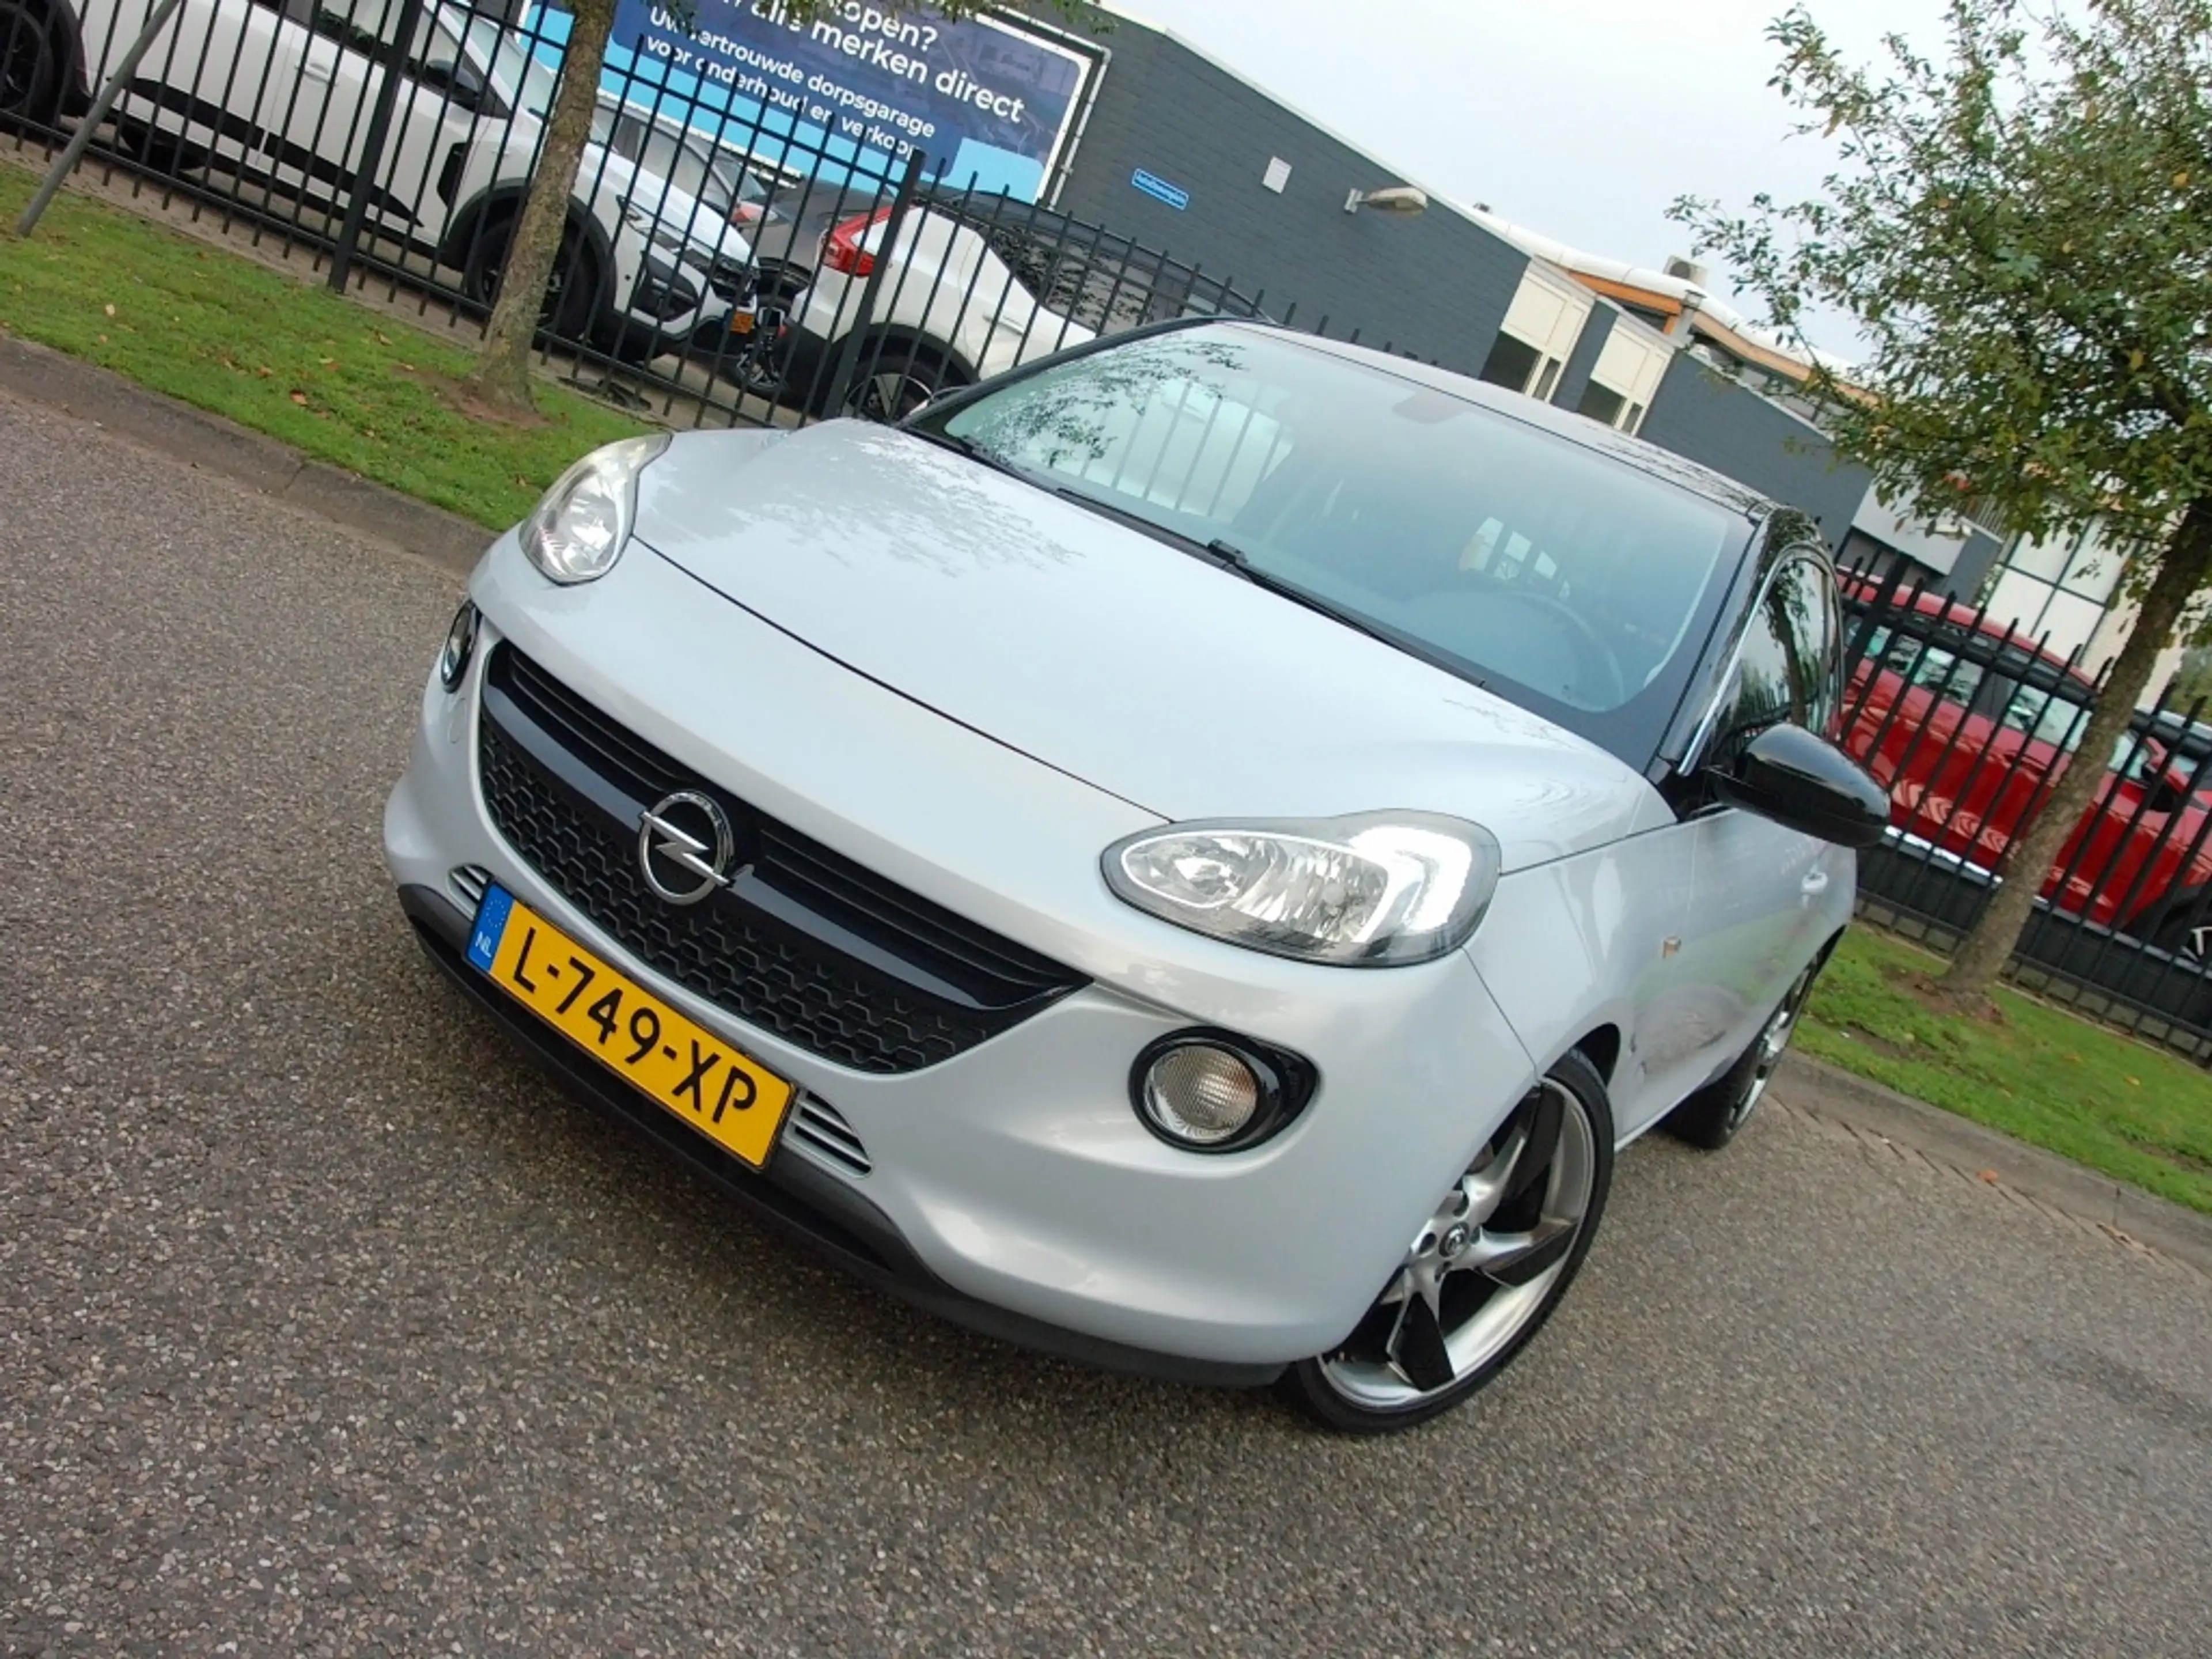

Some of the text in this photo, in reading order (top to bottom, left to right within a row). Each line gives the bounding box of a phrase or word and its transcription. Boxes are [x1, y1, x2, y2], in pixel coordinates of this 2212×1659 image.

[647, 35, 693, 66] voor
[810, 20, 927, 84] merken
[935, 68, 1025, 123] direct
[807, 74, 935, 138] dorpsgarage
[475, 930, 492, 958] NL
[513, 927, 757, 1124] L-749-XP
